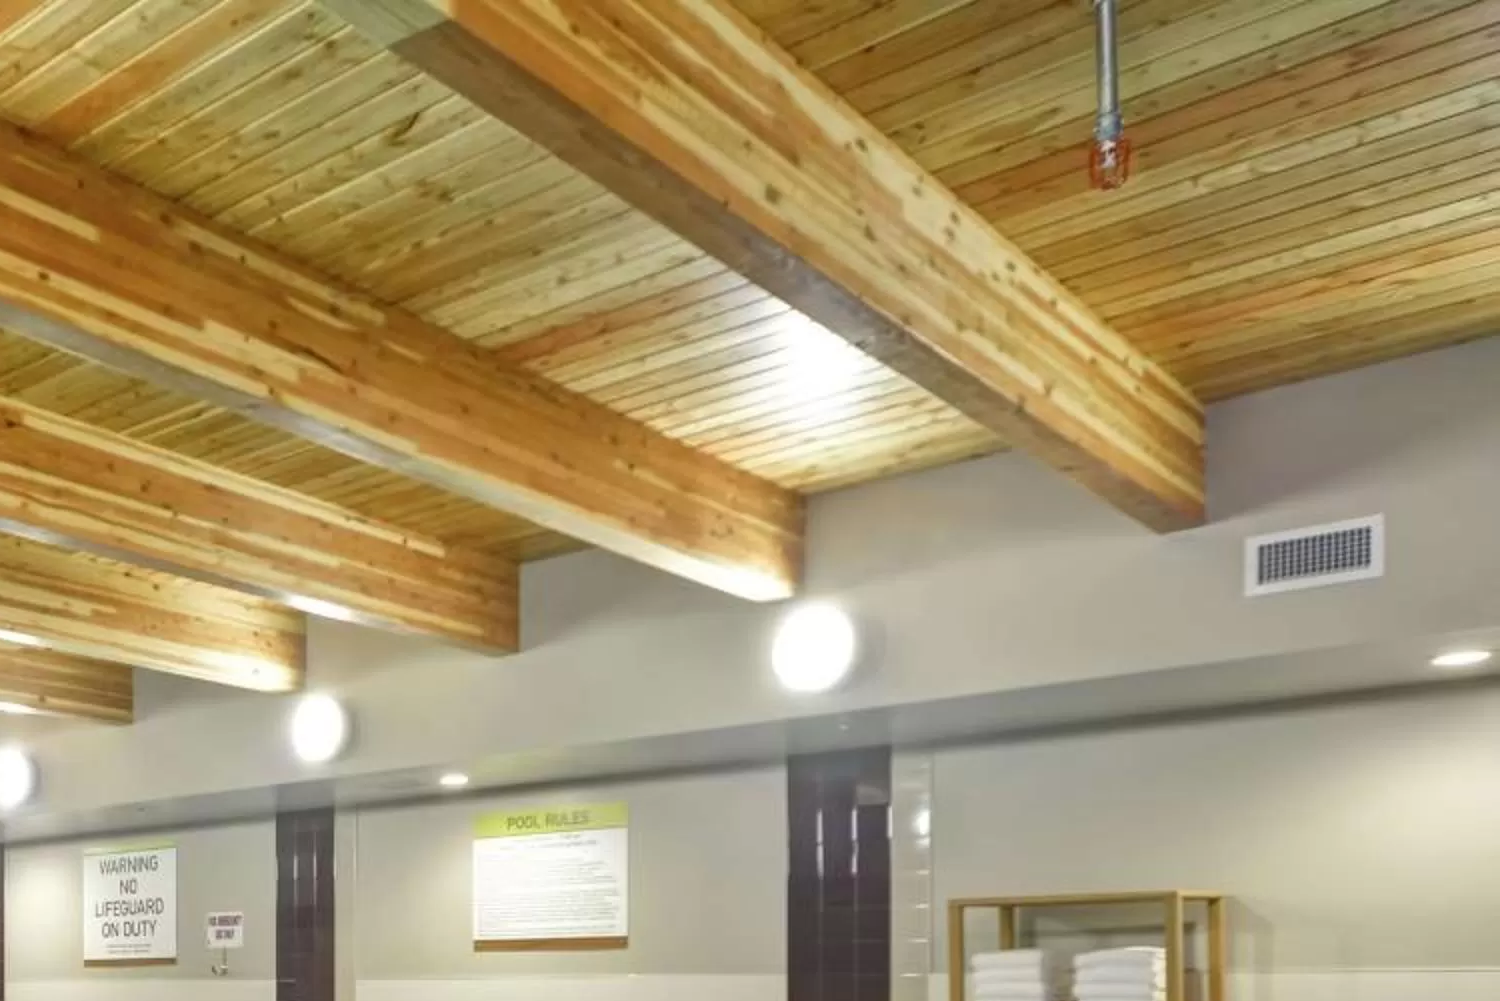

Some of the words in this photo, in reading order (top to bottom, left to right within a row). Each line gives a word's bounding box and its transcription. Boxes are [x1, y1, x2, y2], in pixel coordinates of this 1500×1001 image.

[506, 815, 540, 831] POOL
[544, 809, 590, 828] RULES
[99, 855, 158, 875] WARNING
[119, 878, 137, 895] NO
[95, 896, 165, 918] LIFEGUARD
[102, 920, 119, 939] ON
[123, 919, 157, 937] DUTY
